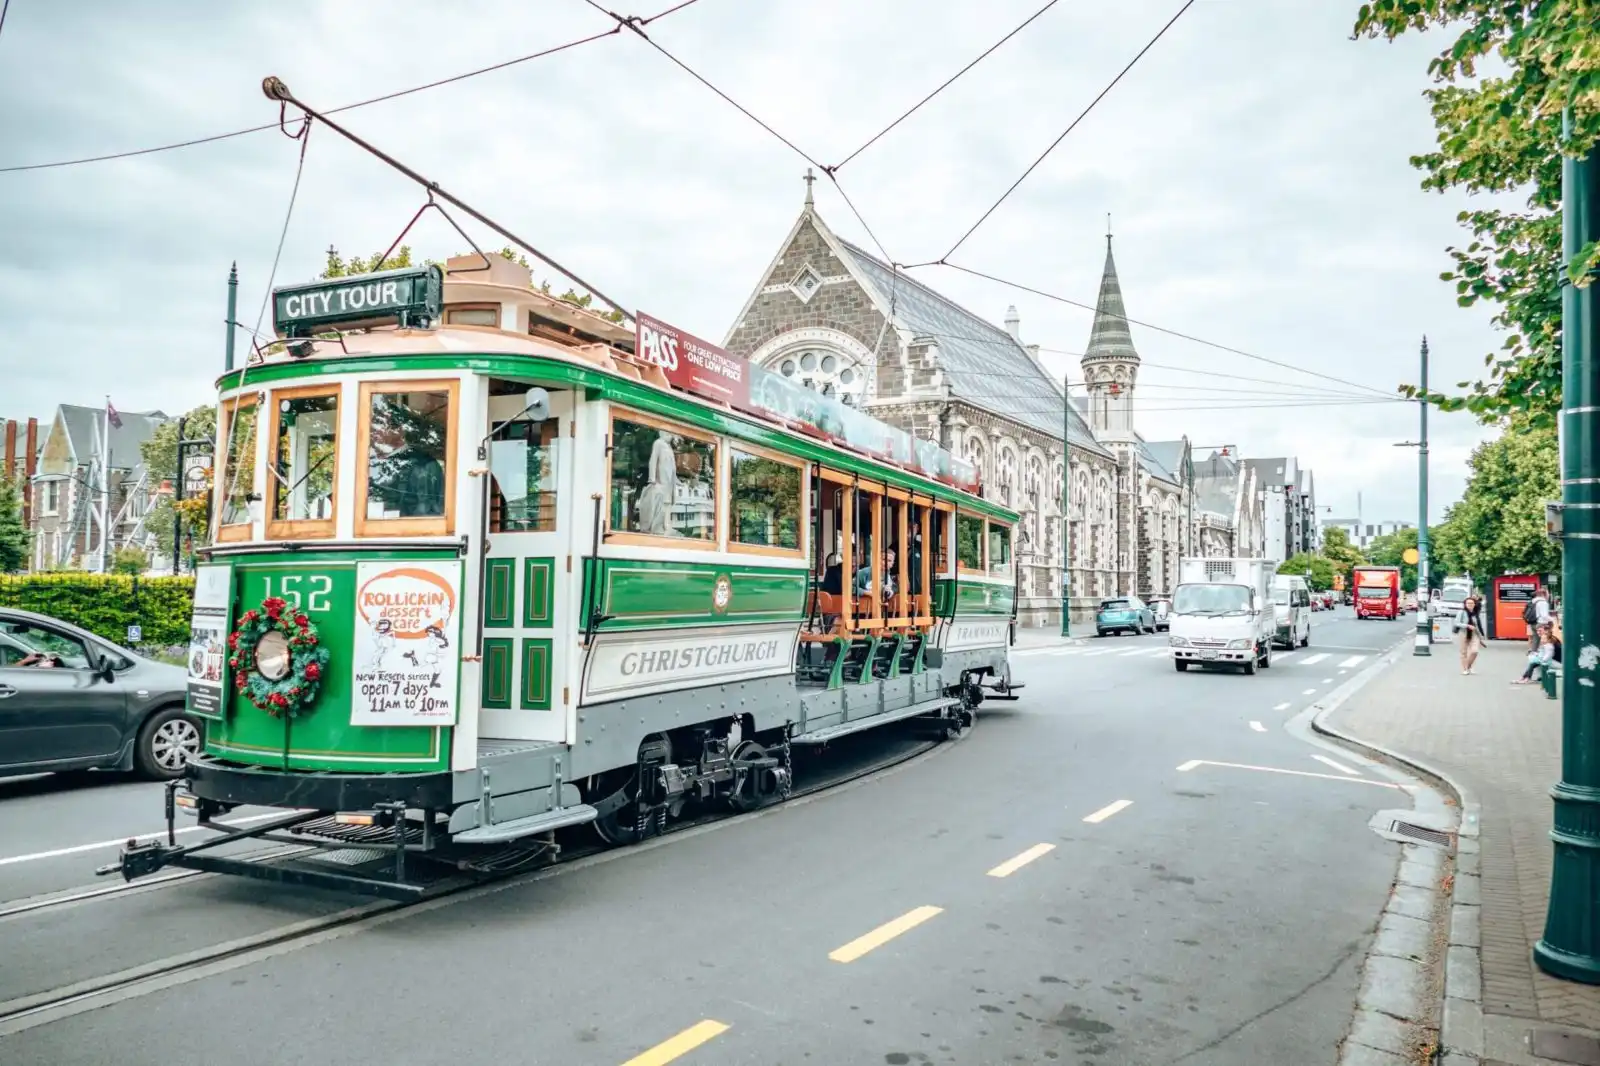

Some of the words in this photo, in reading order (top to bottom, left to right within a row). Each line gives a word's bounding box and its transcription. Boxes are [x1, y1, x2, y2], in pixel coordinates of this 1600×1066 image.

[286, 290, 333, 318] CITY
[337, 281, 400, 310] TOUR
[640, 324, 679, 371] PASS
[684, 341, 697, 353] FOUR
[687, 351, 704, 367] ONE
[704, 358, 721, 374] LOW
[722, 366, 741, 382] PRICE
[262, 575, 333, 611] 152
[380, 606, 432, 618] dessert
[393, 618, 421, 629] cafe
[620, 640, 779, 676] CHRISTCHURCH
[378, 671, 405, 682] Regent
[361, 683, 389, 702] open
[393, 680, 400, 696] 7
[402, 681, 428, 700] days
[405, 698, 416, 709] to
